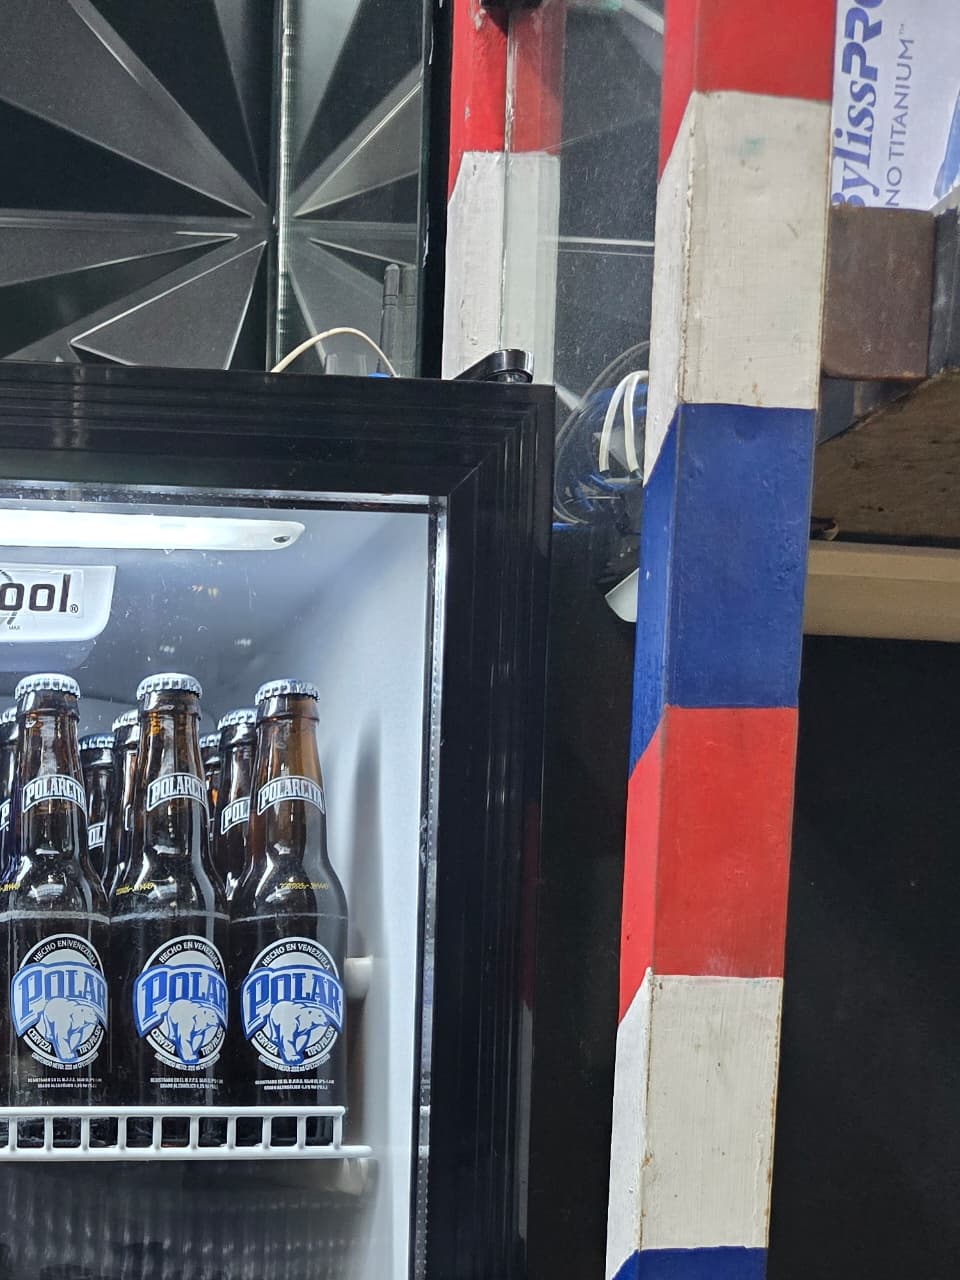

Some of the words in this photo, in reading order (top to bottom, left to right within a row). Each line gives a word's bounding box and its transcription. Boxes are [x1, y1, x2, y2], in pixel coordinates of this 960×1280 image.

[33, 942, 56, 962] HECHO
[57, 940, 67, 948] EN
[159, 944, 182, 963] HECHO
[262, 946, 285, 966] HECHO
[286, 943, 296, 951] EN
[19, 970, 106, 1019] POLAR
[142, 971, 226, 1020] POLAR
[247, 972, 339, 1022] POLAR
